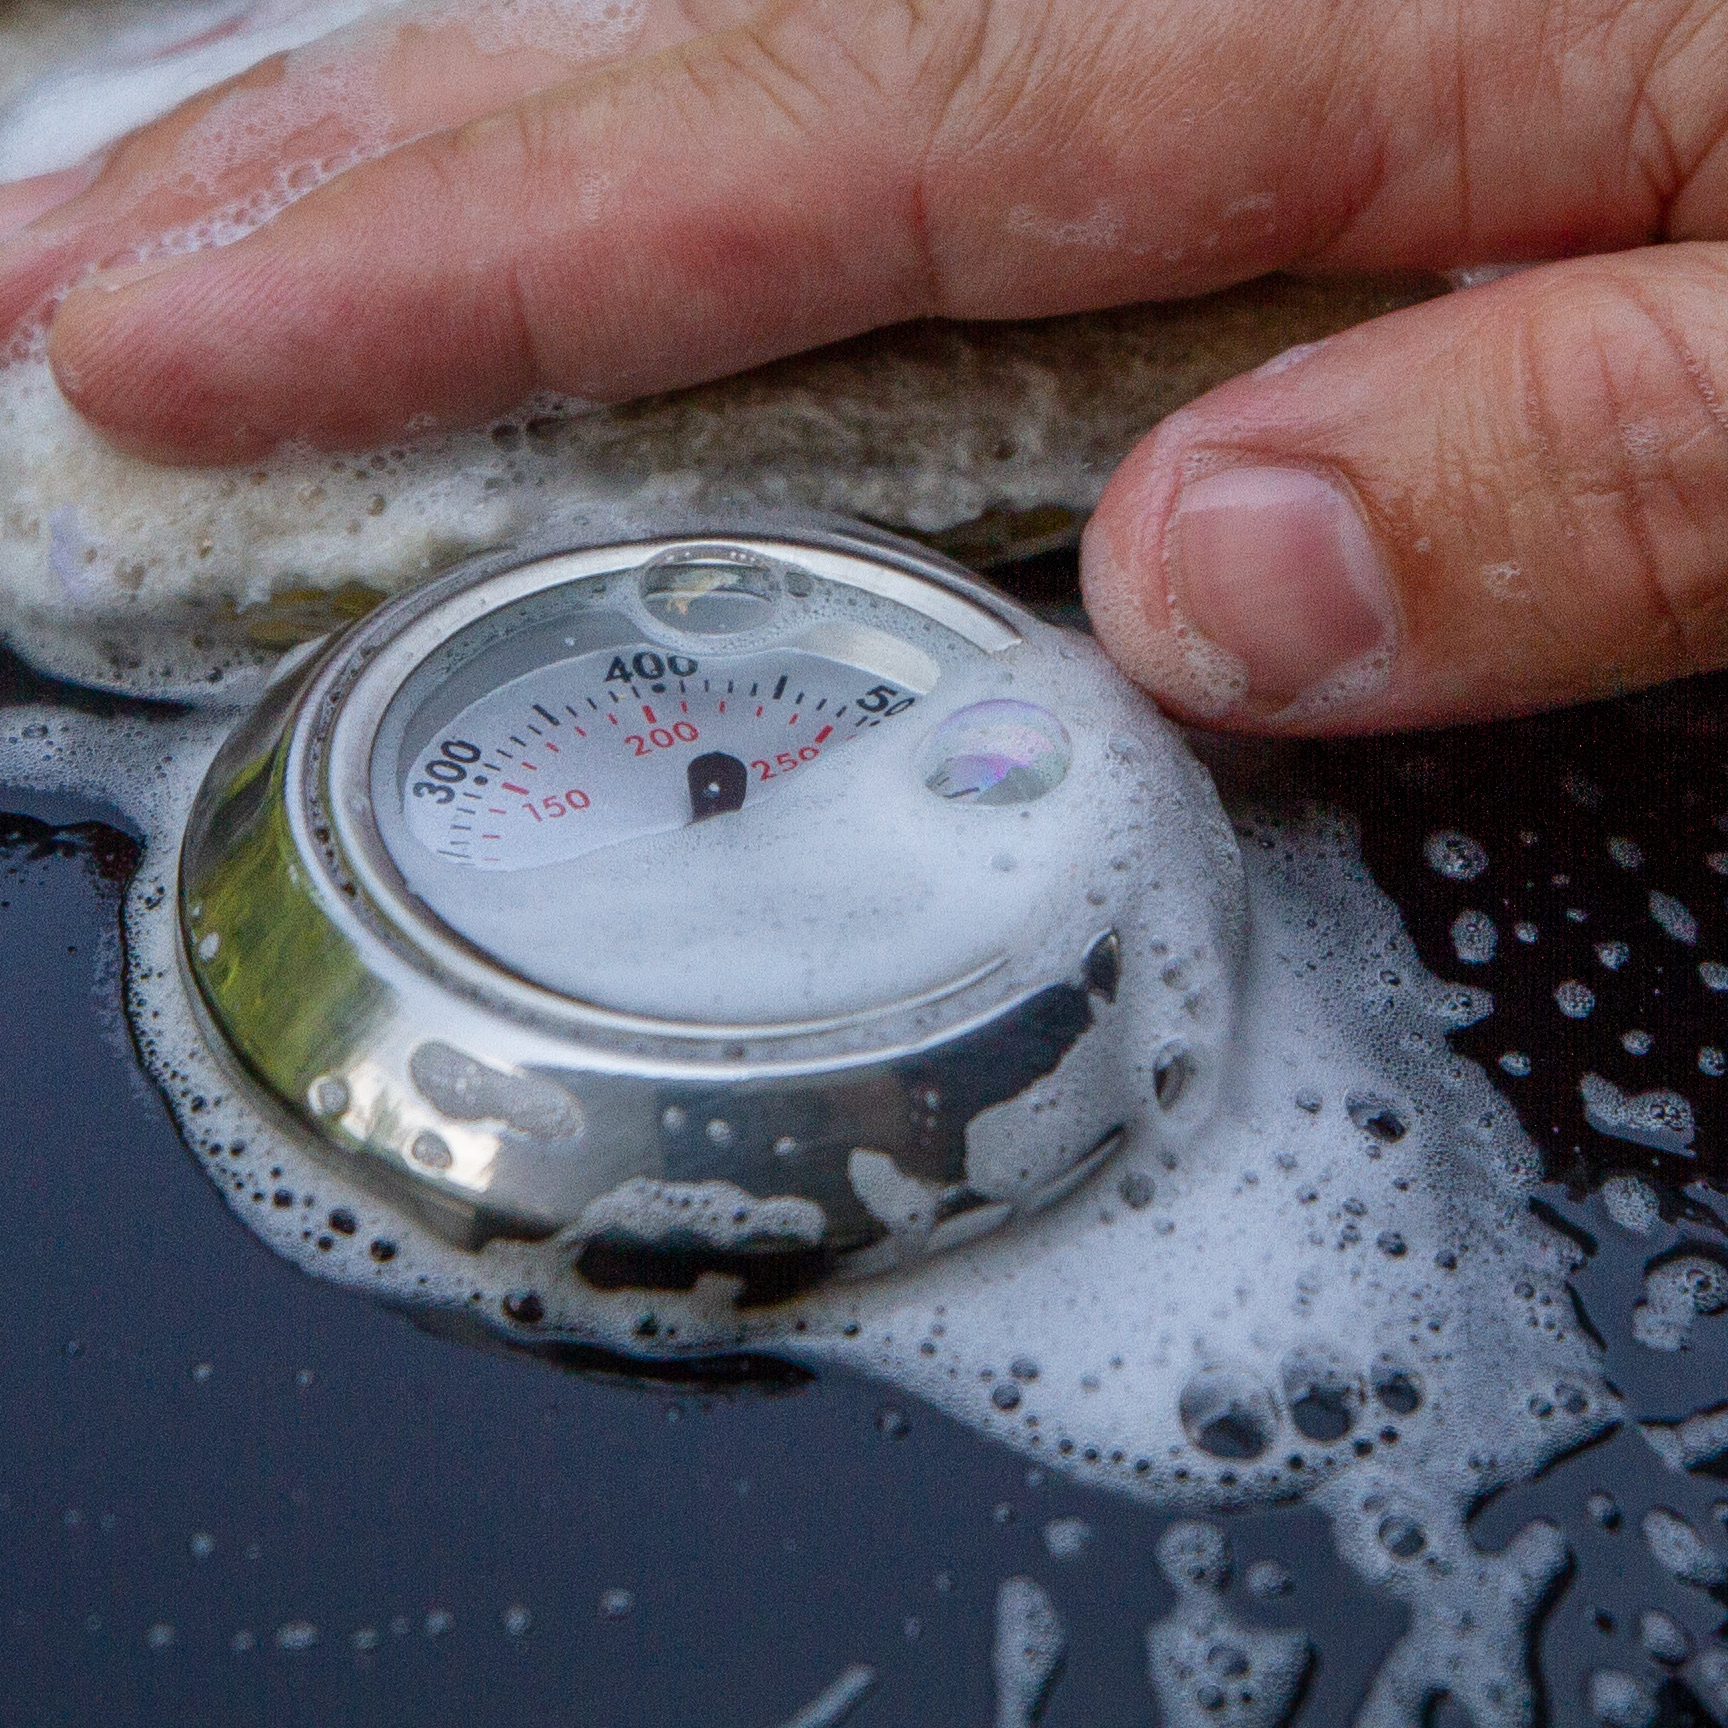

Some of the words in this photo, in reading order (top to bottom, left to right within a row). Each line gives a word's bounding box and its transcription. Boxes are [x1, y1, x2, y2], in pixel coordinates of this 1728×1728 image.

[603, 651, 699, 683] 400
[624, 721, 700, 756] 200
[413, 740, 481, 805] 300
[750, 746, 820, 781] 250
[522, 789, 591, 822] 150
